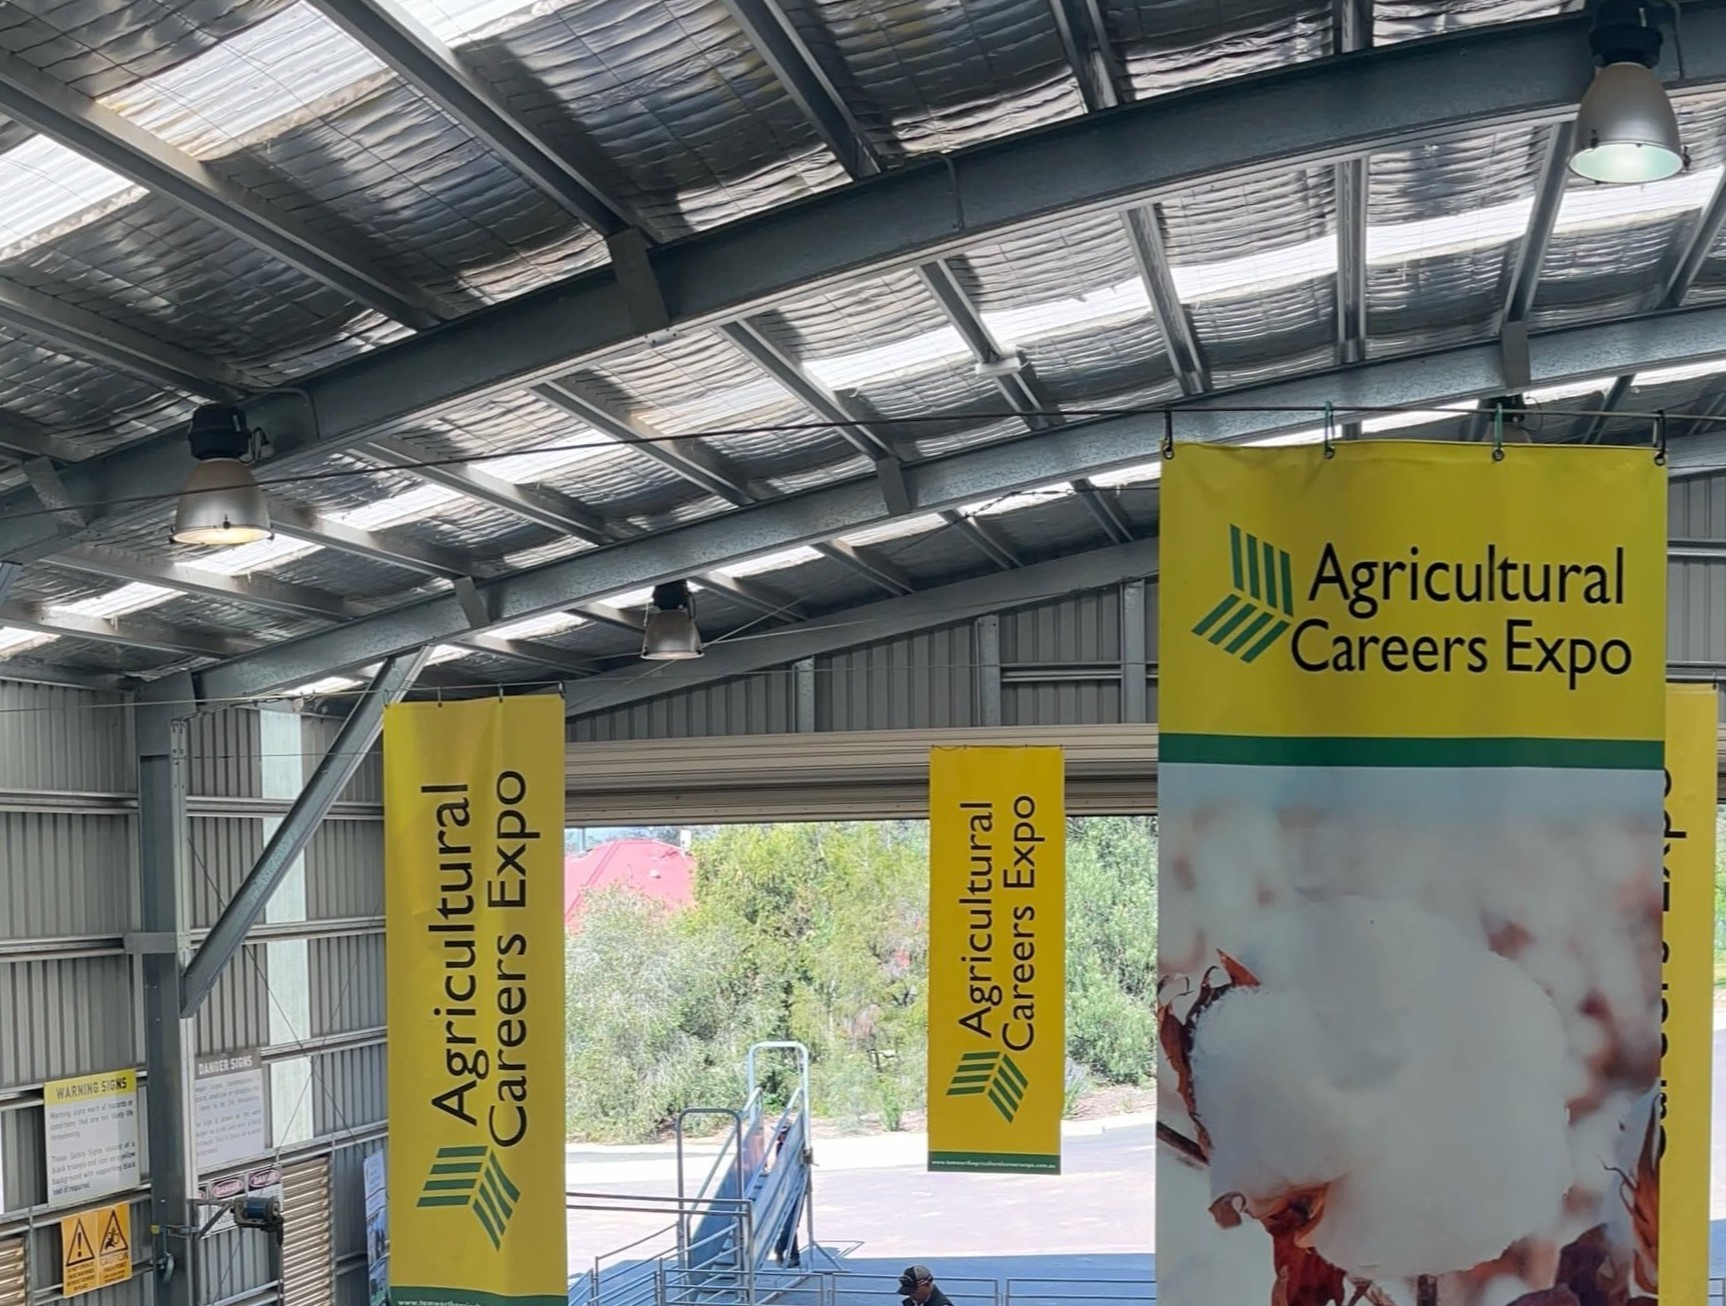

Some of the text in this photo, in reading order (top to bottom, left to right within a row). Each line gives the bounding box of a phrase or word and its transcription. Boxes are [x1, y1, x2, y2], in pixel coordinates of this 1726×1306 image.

[1291, 617, 1633, 691] Careers Expo
[1307, 542, 1624, 619] Agricultural
[420, 783, 490, 1126] Agricultural
[487, 770, 541, 1148] Careers Expo
[958, 801, 1003, 1038] Agricultural
[1002, 795, 1045, 1052] Careers Expo
[56, 1077, 127, 1100] WARNING SIGNS
[199, 1055, 252, 1075] DANGER SIGNS
